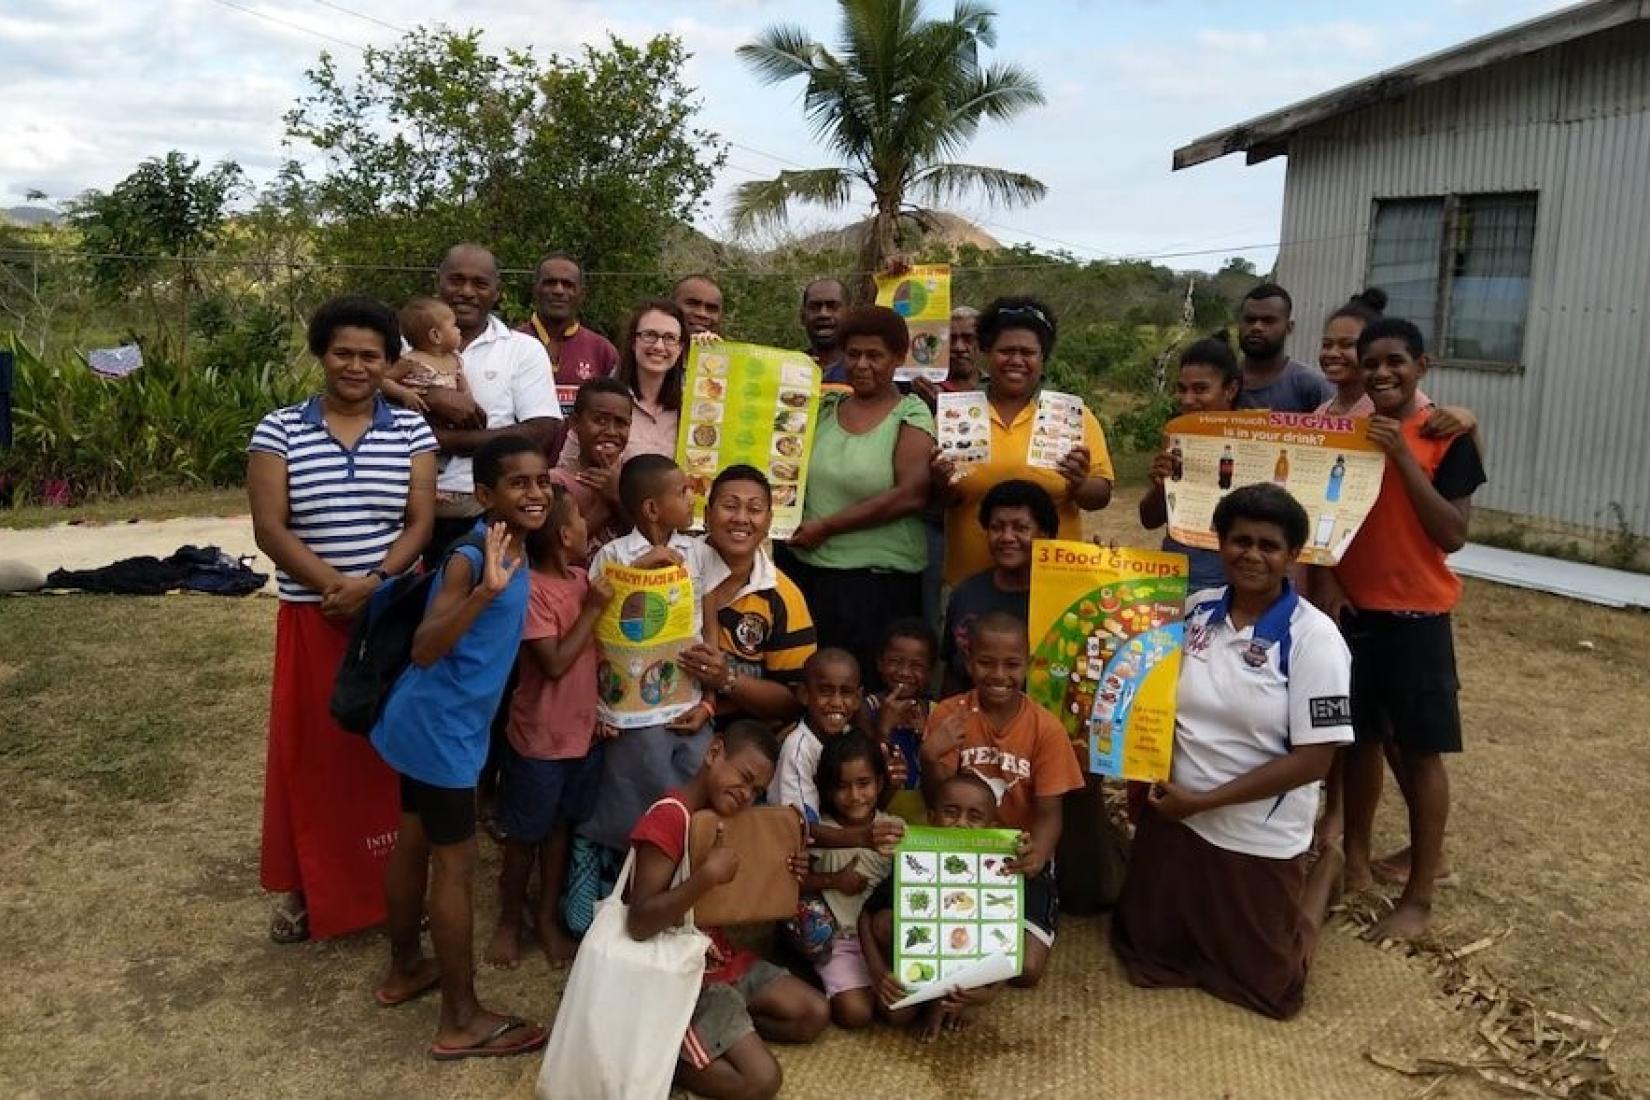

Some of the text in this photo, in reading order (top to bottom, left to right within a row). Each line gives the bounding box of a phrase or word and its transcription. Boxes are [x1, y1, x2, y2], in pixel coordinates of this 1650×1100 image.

[1199, 412, 1354, 432] How much SUGAR
[1236, 428, 1249, 438] in
[1251, 430, 1280, 441] your
[1283, 431, 1327, 446] drink?
[1038, 547, 1050, 563] 3
[1055, 548, 1102, 565] Food
[1108, 553, 1181, 578] Groups
[960, 746, 1031, 778] TEXAS
